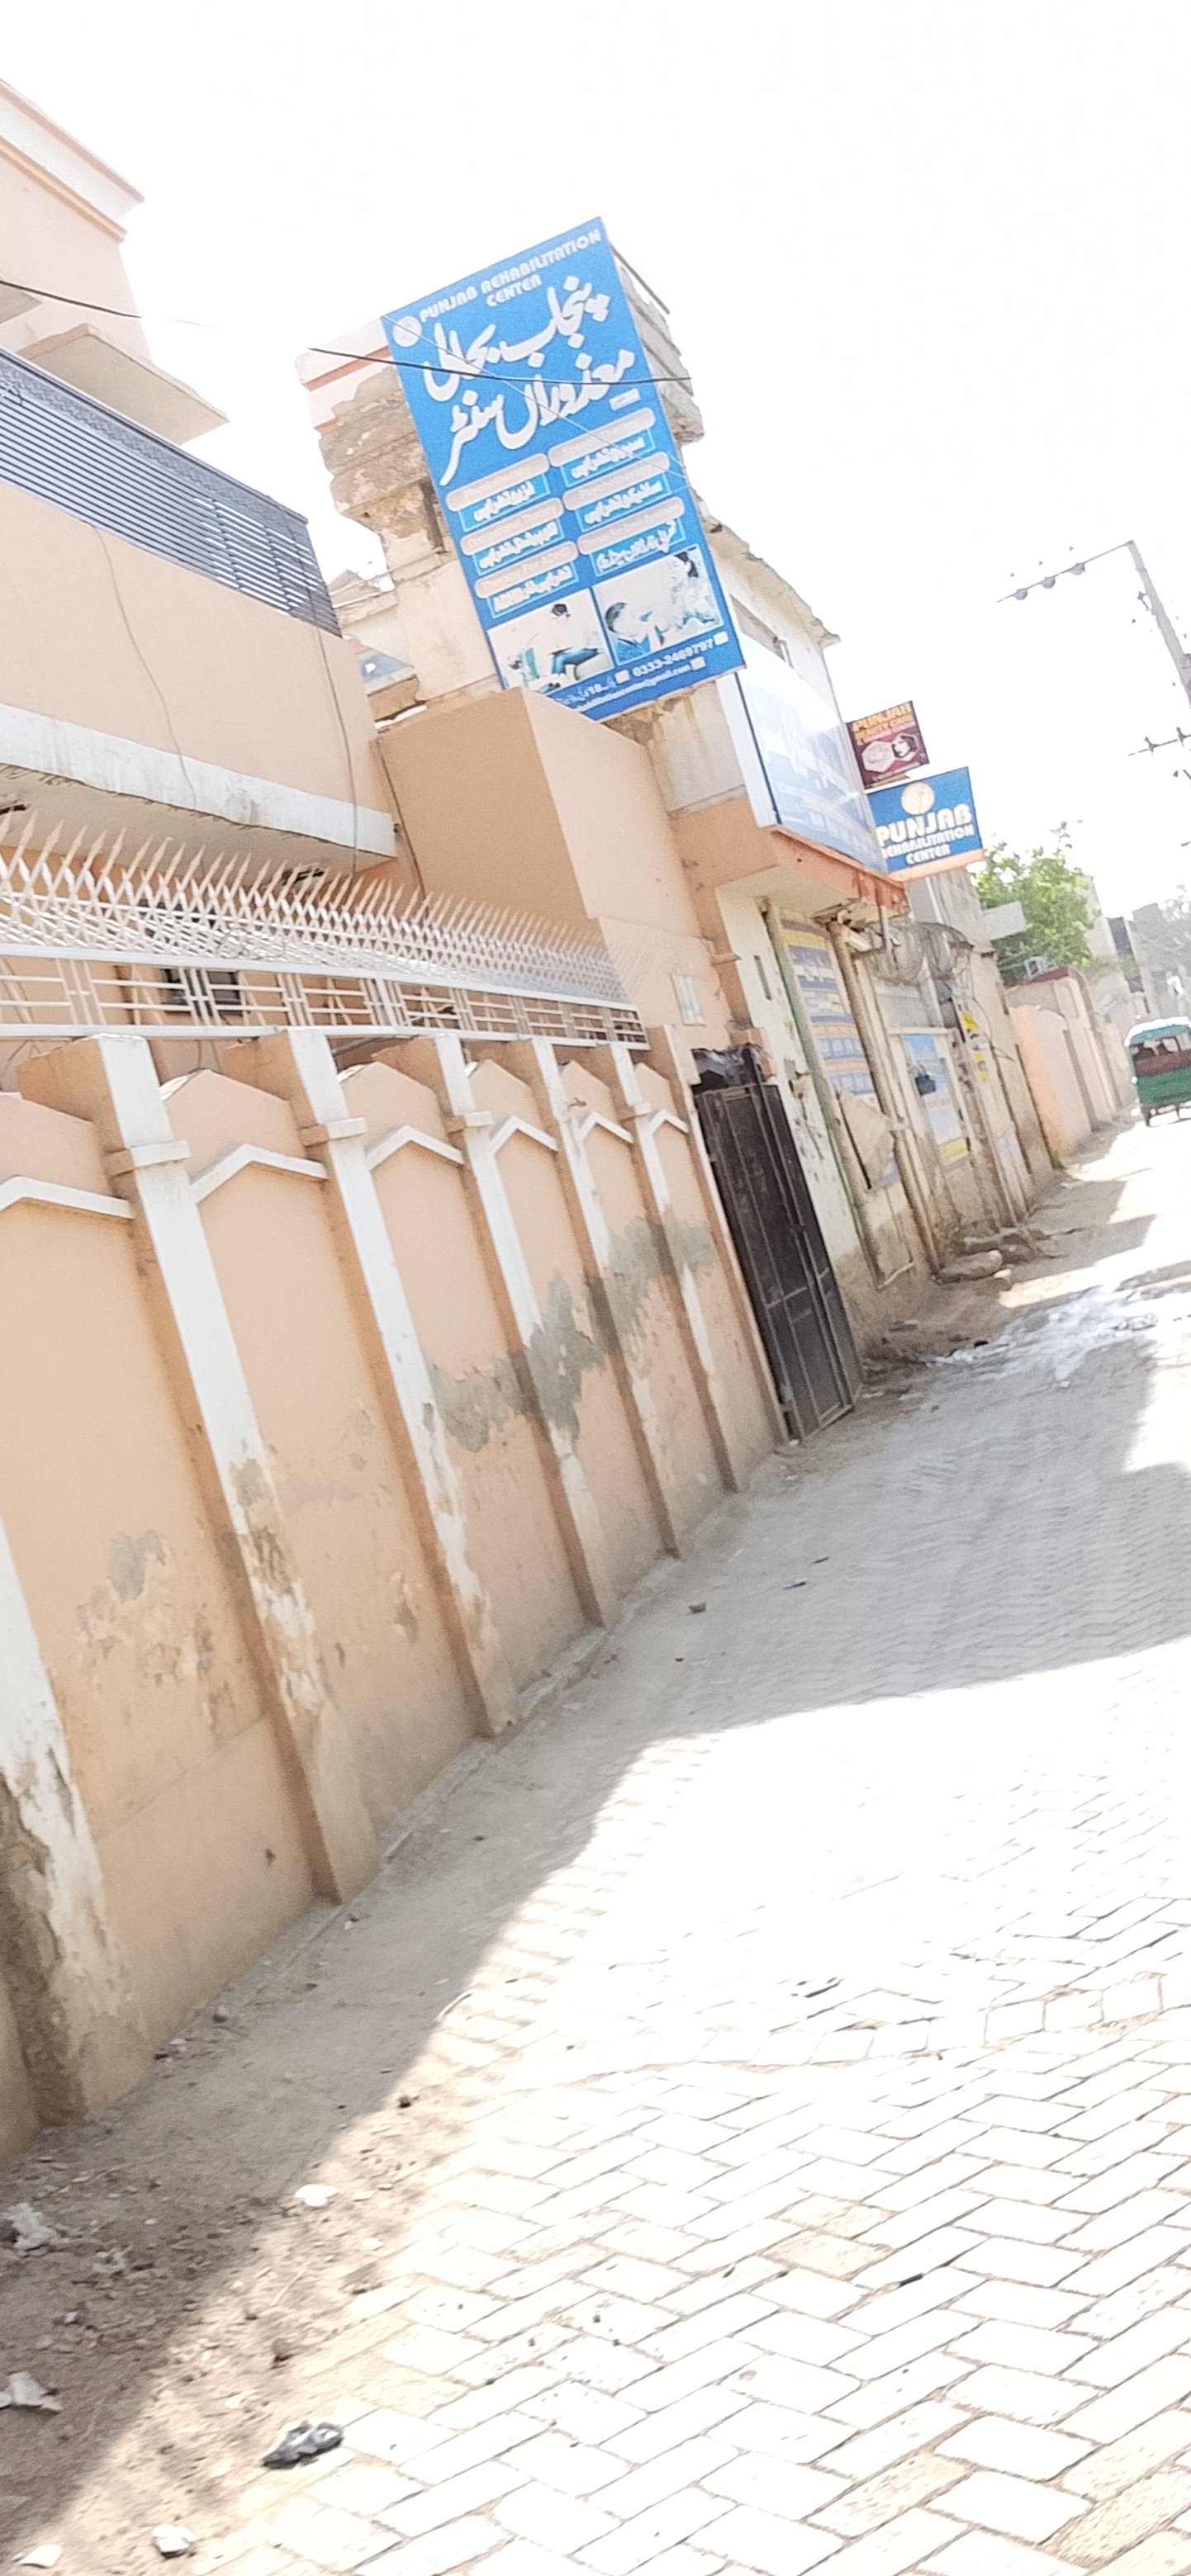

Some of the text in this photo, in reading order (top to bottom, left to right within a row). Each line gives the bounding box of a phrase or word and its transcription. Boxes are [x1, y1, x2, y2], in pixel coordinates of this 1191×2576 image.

[419, 229, 602, 322] PUNJAB REHABILITATION
[486, 274, 542, 307] CENTER
[499, 275, 610, 368] پنجاب
[875, 803, 973, 847] PUNJAB
[905, 844, 950, 865] CENTER
